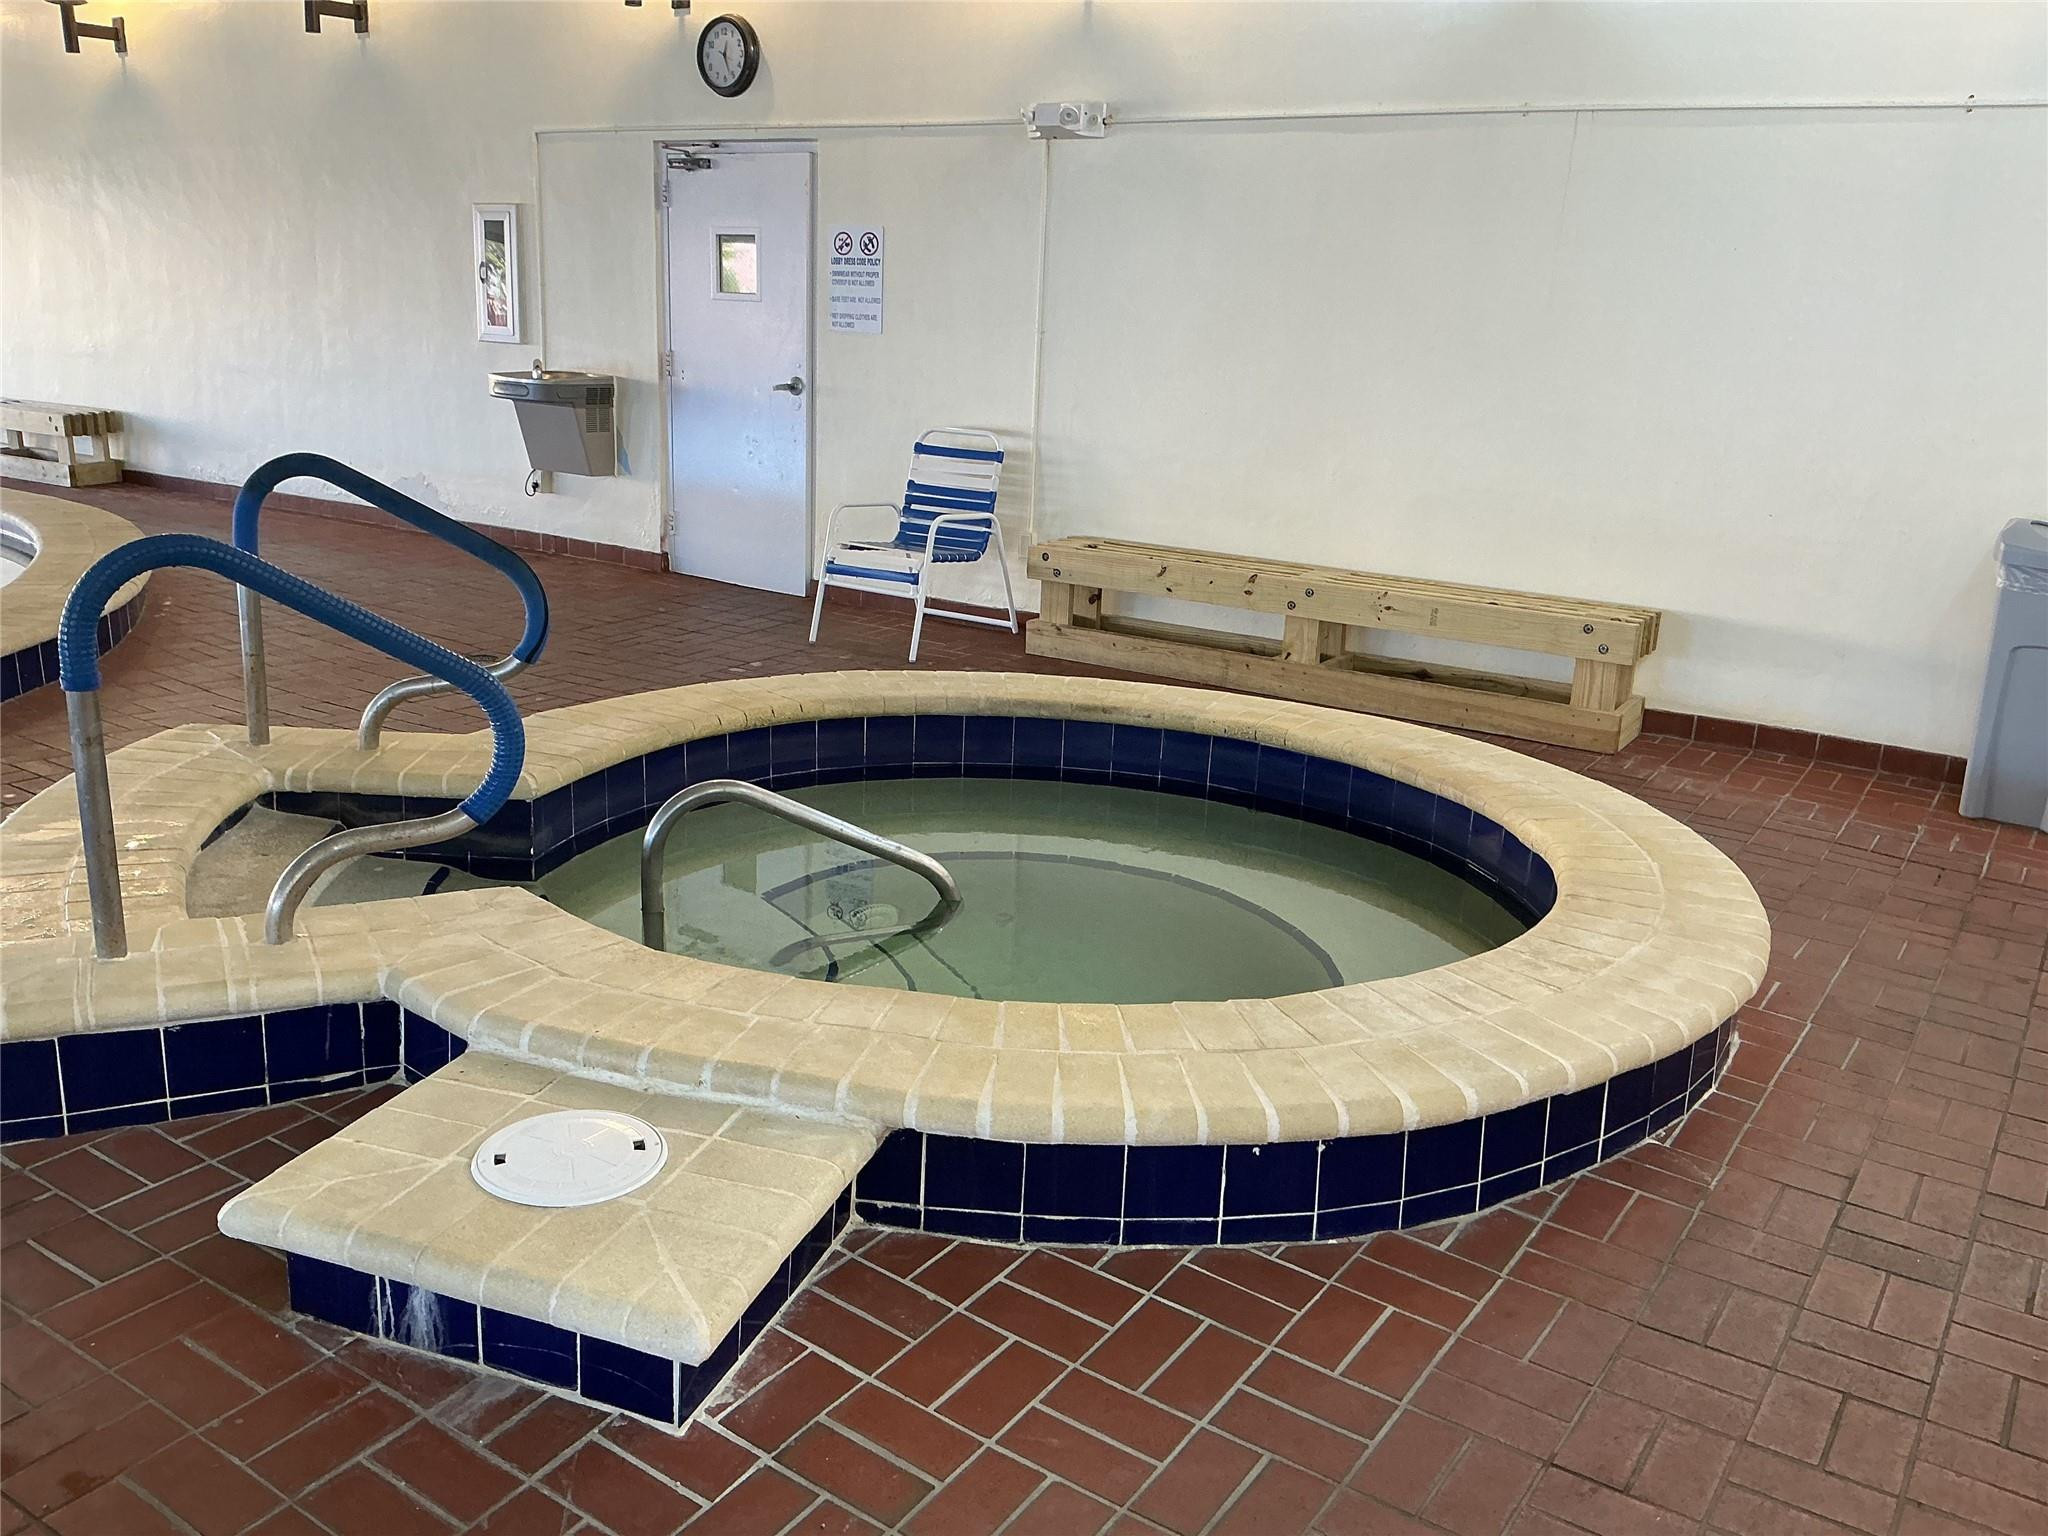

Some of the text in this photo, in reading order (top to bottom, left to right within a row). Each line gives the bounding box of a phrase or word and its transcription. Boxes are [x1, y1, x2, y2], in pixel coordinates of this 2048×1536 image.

[720, 27, 728, 36] 12
[831, 257, 881, 266] LOBBY DRESS CODE POLICY
[866, 271, 880, 279] PROPER
